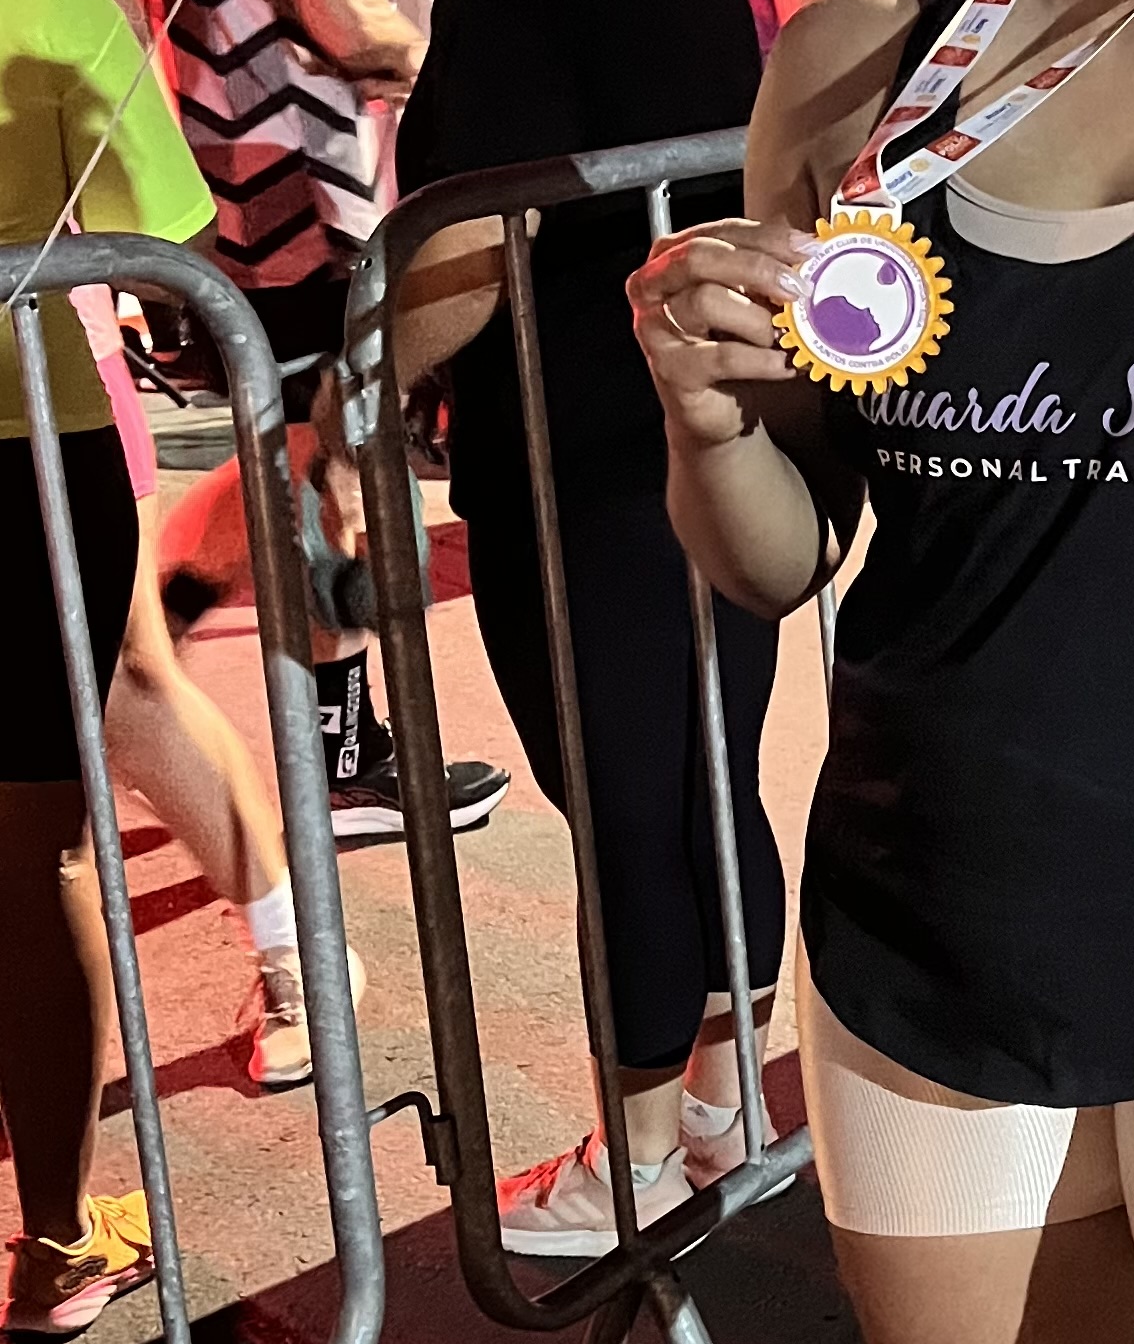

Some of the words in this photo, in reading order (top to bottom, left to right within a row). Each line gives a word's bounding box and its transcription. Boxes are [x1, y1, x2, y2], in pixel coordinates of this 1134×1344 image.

[835, 237, 858, 248] CLUB
[860, 237, 873, 245] DE
[856, 361, 1077, 435] duarda
[876, 448, 1048, 483] PERSONAL
